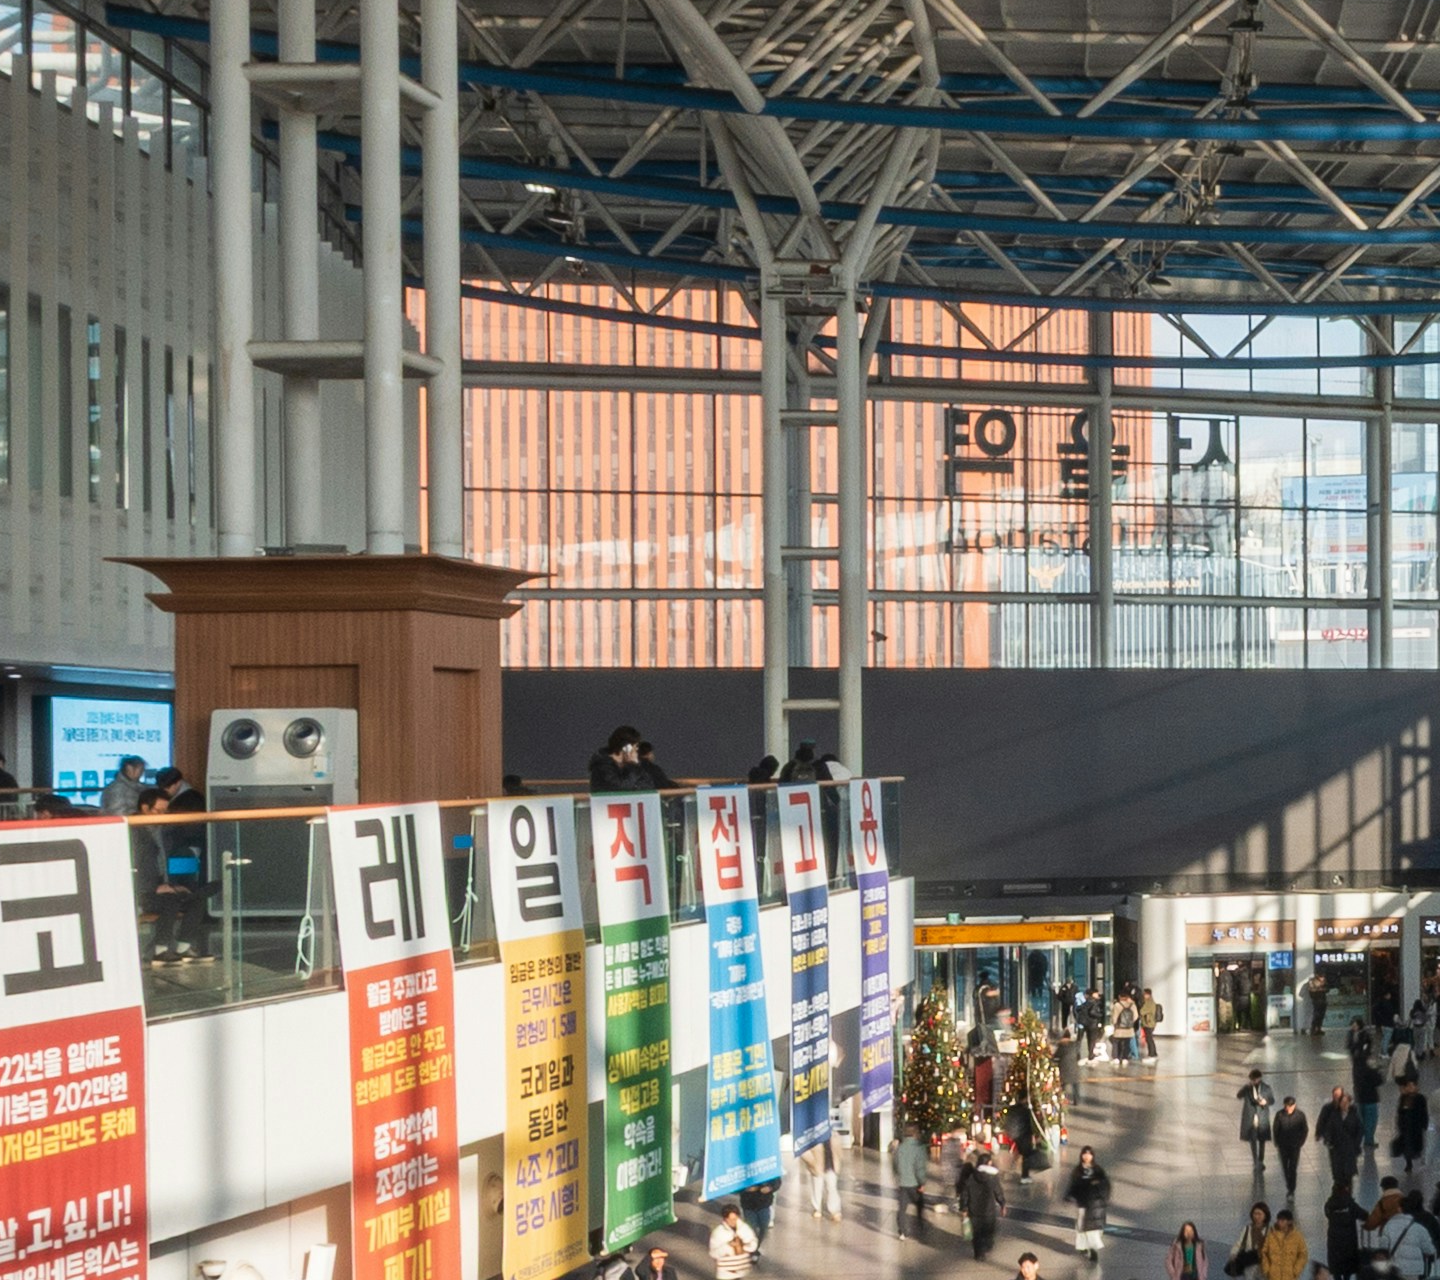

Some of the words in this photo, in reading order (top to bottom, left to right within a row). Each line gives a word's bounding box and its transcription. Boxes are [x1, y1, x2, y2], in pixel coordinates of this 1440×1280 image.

[708, 794, 745, 892] 접
[788, 790, 820, 875] 고
[859, 779, 879, 867] 용
[509, 803, 564, 923] 일
[608, 801, 653, 907] 직
[354, 813, 430, 944] 레
[1212, 926, 1270, 942] 누리분식
[1317, 926, 1359, 936] ginseng
[1362, 924, 1399, 935] 호두과자
[366, 976, 392, 1010] 월급
[392, 968, 438, 1000] 주겠다고
[509, 962, 536, 985] 임금은
[538, 954, 564, 979] 원청의
[378, 1004, 414, 1037] 받아온
[415, 1000, 428, 1027] 돈
[521, 978, 573, 1016] 근무시간은
[66, 1035, 122, 1076] 일해도
[361, 1034, 408, 1073] 월급으로
[410, 1032, 422, 1057] 안
[423, 1025, 447, 1054] 주고
[515, 1019, 548, 1050] 원청의
[355, 1073, 393, 1107] 원청에
[393, 1066, 417, 1096] 도로
[418, 1053, 453, 1088] 헌납?!
[520, 1053, 576, 1101] 코레일과
[608, 1039, 670, 1085] 상시지속업무
[53, 1071, 128, 1123] 202만원
[528, 1098, 569, 1143] 동일한
[619, 1077, 660, 1117] 직접고용
[100, 1105, 137, 1144] 못해
[373, 1106, 439, 1161] 중간착취
[624, 1114, 656, 1151] 약속을
[375, 1153, 439, 1206] 조장하는
[516, 1152, 542, 1190] 4조
[546, 1138, 580, 1180] 2교대
[615, 1146, 663, 1193] 이행하라!
[364, 1206, 415, 1254] 기재부
[418, 1187, 452, 1233] 지침
[515, 1196, 546, 1237] 당장
[548, 1180, 580, 1222] 시행!
